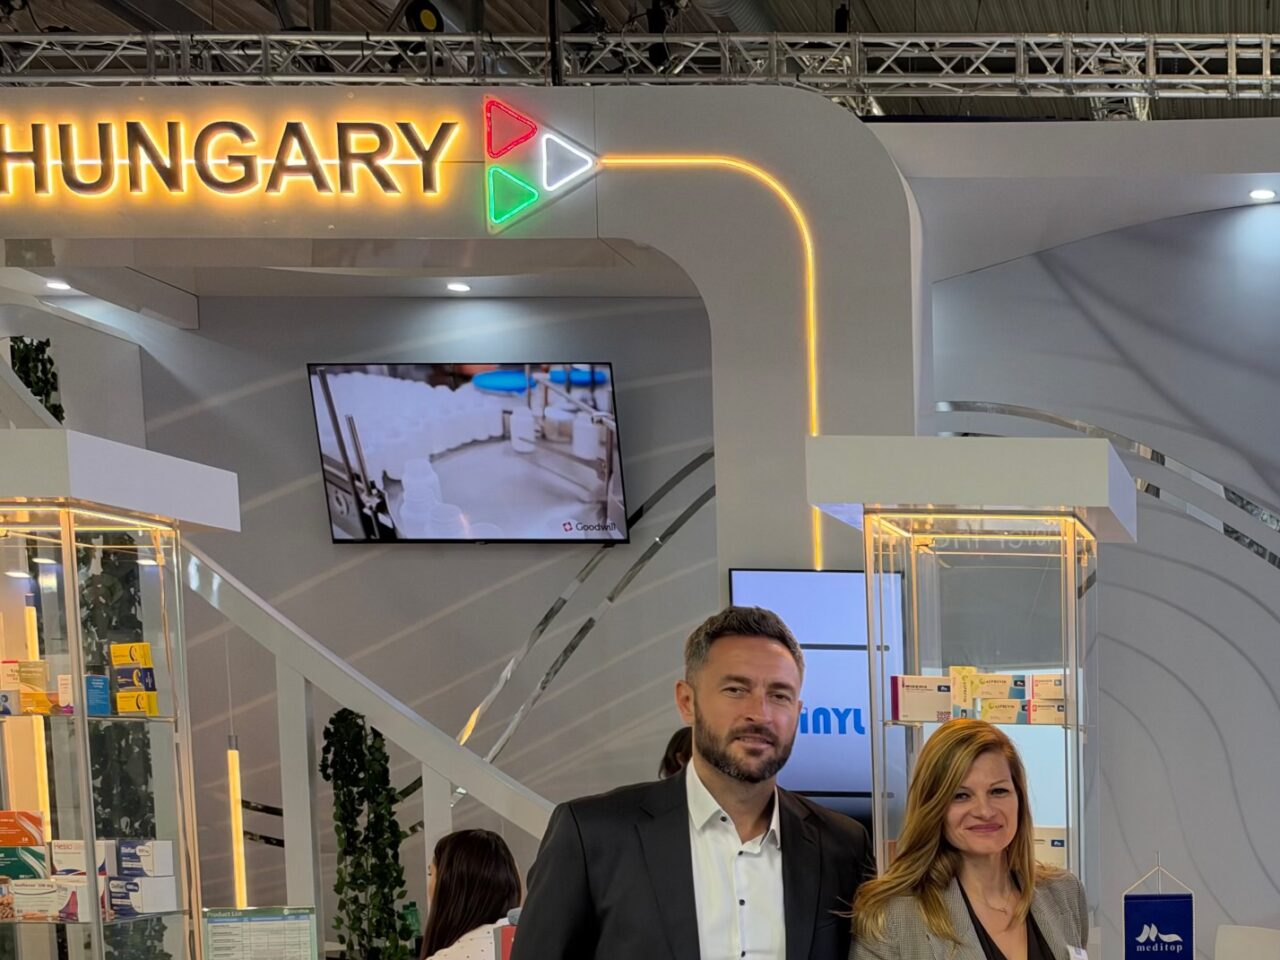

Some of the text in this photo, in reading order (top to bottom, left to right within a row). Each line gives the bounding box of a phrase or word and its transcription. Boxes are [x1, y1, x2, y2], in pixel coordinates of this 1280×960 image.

[0, 121, 459, 195] HUNGARY
[575, 521, 617, 532] Goodwill
[1136, 943, 1184, 954] meditop
